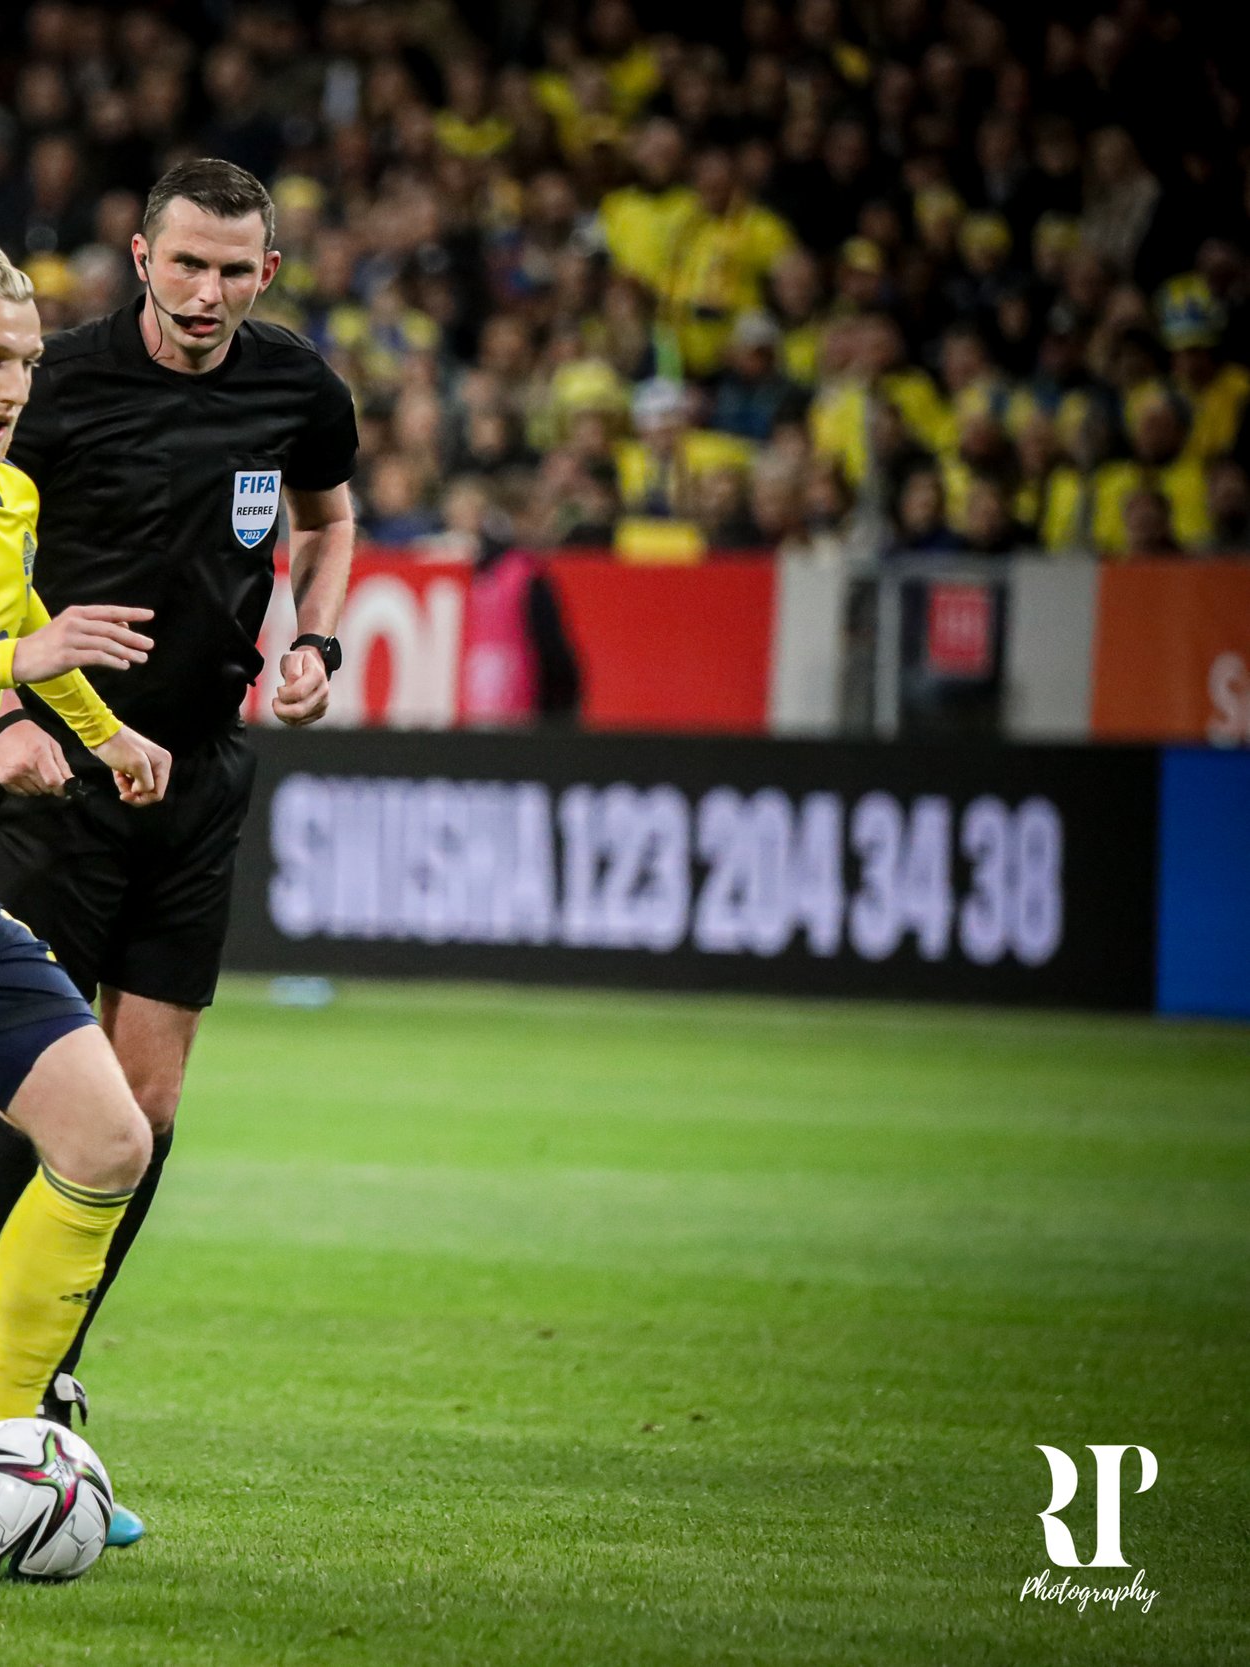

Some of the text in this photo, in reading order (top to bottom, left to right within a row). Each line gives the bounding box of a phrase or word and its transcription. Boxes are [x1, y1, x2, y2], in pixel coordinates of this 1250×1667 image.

[239, 475, 276, 494] FIFA
[236, 505, 274, 516] REFEREE
[242, 530, 261, 540] 2022
[558, 782, 691, 952] 123
[692, 786, 843, 957] 204
[849, 790, 950, 961] 34
[959, 795, 1064, 966] 38
